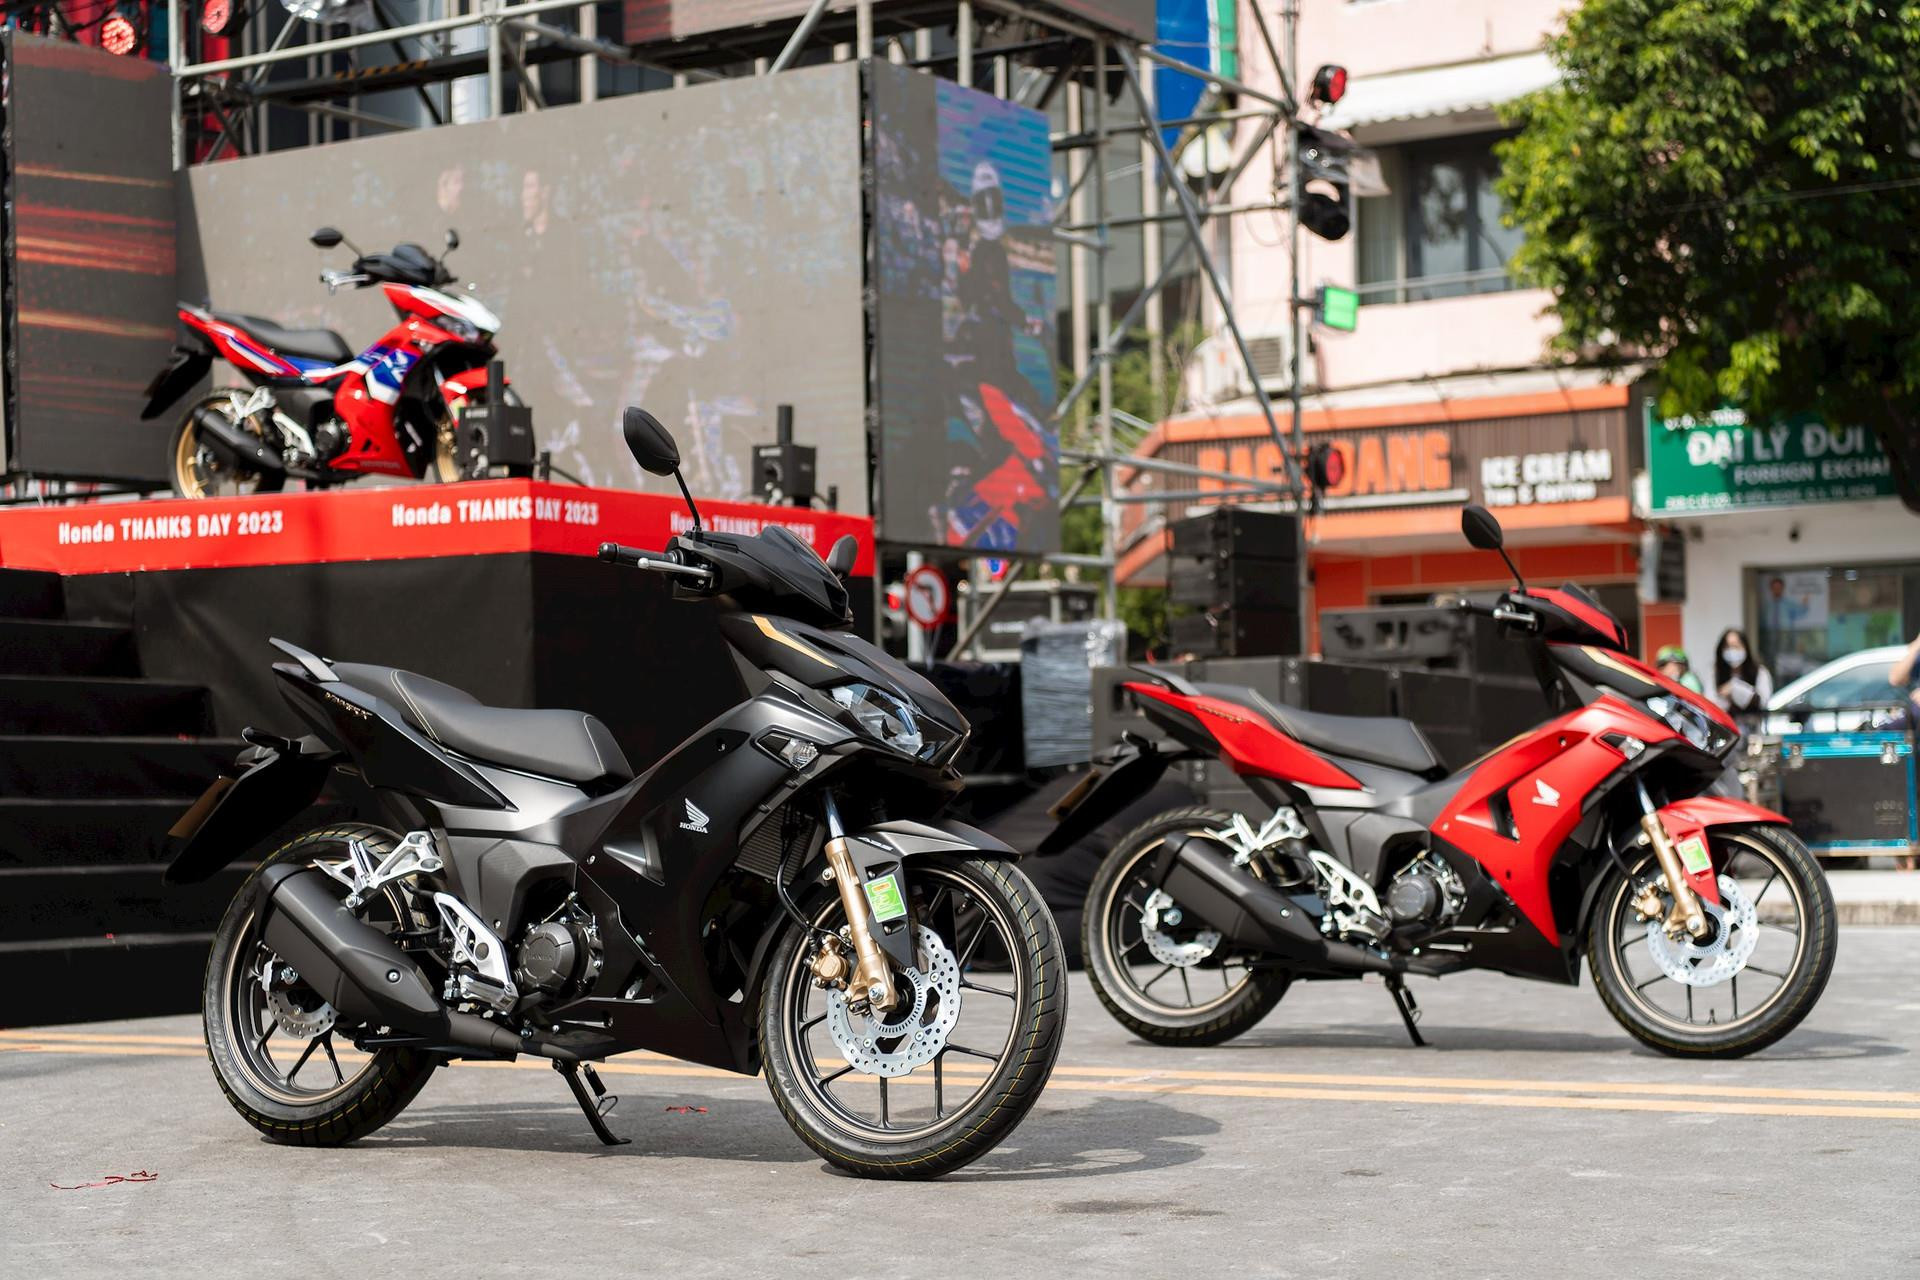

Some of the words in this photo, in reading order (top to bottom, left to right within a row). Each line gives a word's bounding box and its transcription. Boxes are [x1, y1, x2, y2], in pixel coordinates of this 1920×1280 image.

[1481, 455, 1519, 487] ICE
[1522, 448, 1612, 484] CREAM
[1734, 462, 1815, 486] FOREIGN
[392, 502, 452, 526] Honda
[457, 496, 532, 522] THANKS
[535, 497, 562, 521] DAY
[564, 500, 599, 525] 2023
[58, 520, 115, 545] Honda
[119, 515, 192, 541] THANKS
[197, 513, 232, 537] DAY
[237, 510, 283, 535] 2023
[679, 821, 709, 834] HONDA
